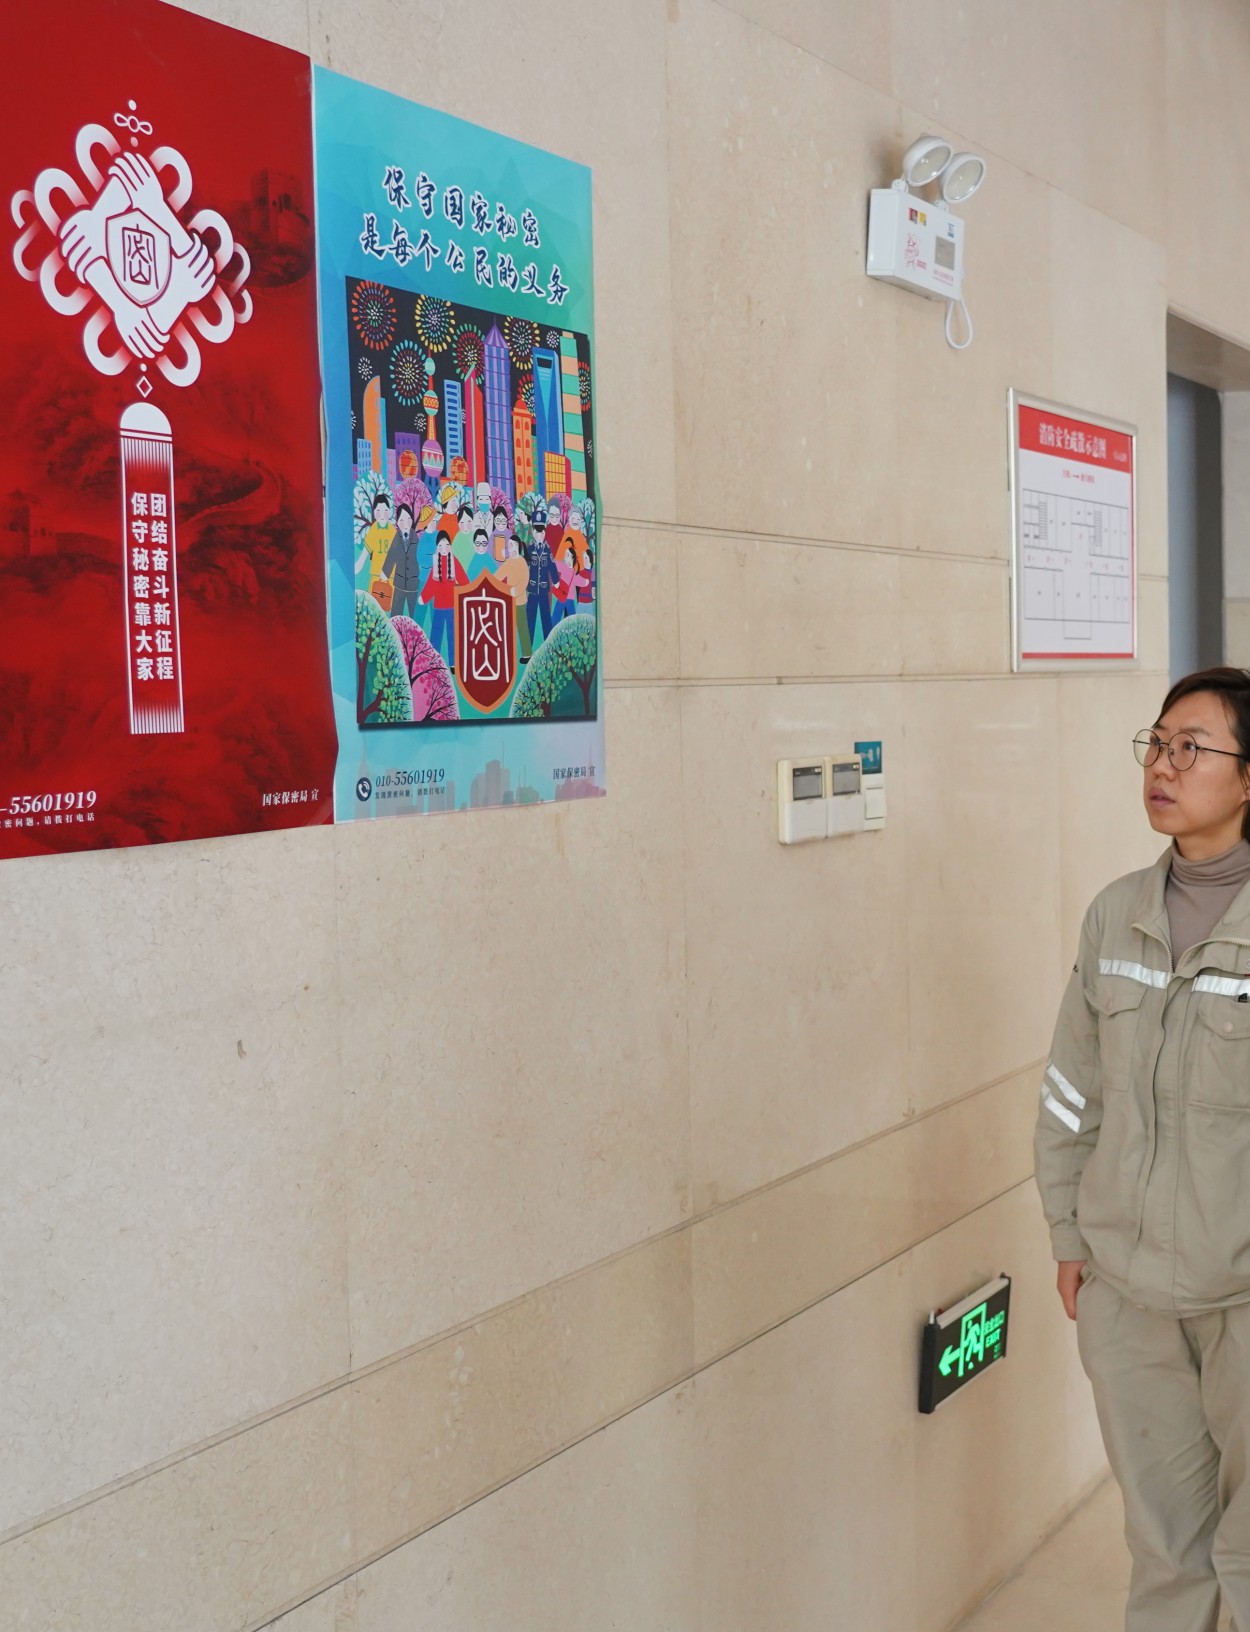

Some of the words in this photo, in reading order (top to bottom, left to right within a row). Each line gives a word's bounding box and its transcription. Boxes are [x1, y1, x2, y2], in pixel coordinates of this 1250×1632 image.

[382, 165, 540, 248] 保守国家秘密
[360, 213, 569, 306] 是每个公民的义务
[131, 491, 155, 682] 保守秘密靠大家
[150, 492, 175, 681] 团结奋斗新征程
[262, 789, 308, 807] 国家保密局
[375, 767, 446, 788] 010-55601919
